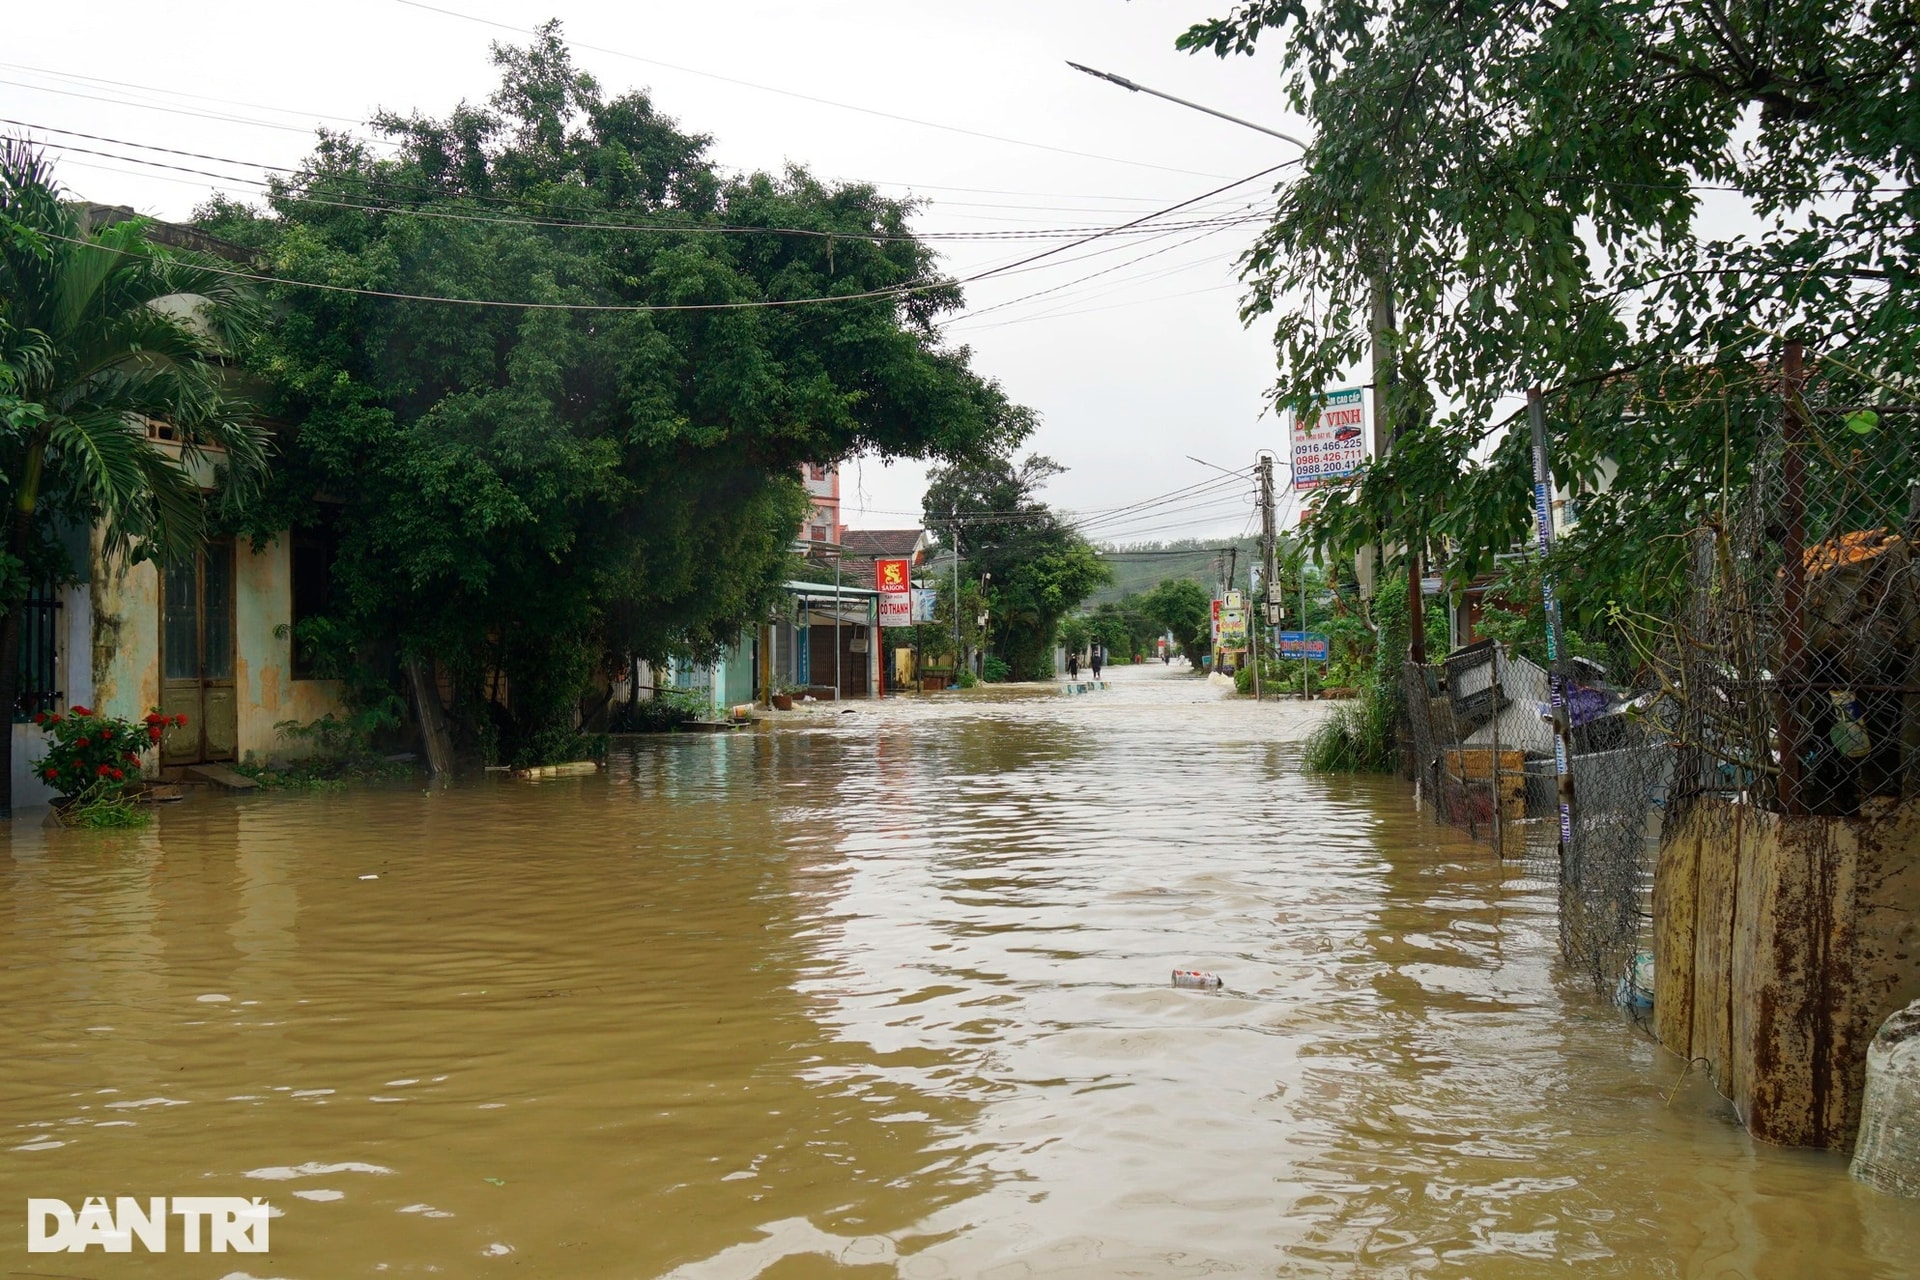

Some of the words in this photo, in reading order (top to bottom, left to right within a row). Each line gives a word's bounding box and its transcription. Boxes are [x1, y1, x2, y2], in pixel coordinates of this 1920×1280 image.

[1337, 395, 1348, 404] CAO
[1295, 413, 1322, 431] BY
[1326, 409, 1361, 427] VINH
[1295, 439, 1362, 454] 0916.466.225
[1296, 450, 1362, 465] 0986.426.711
